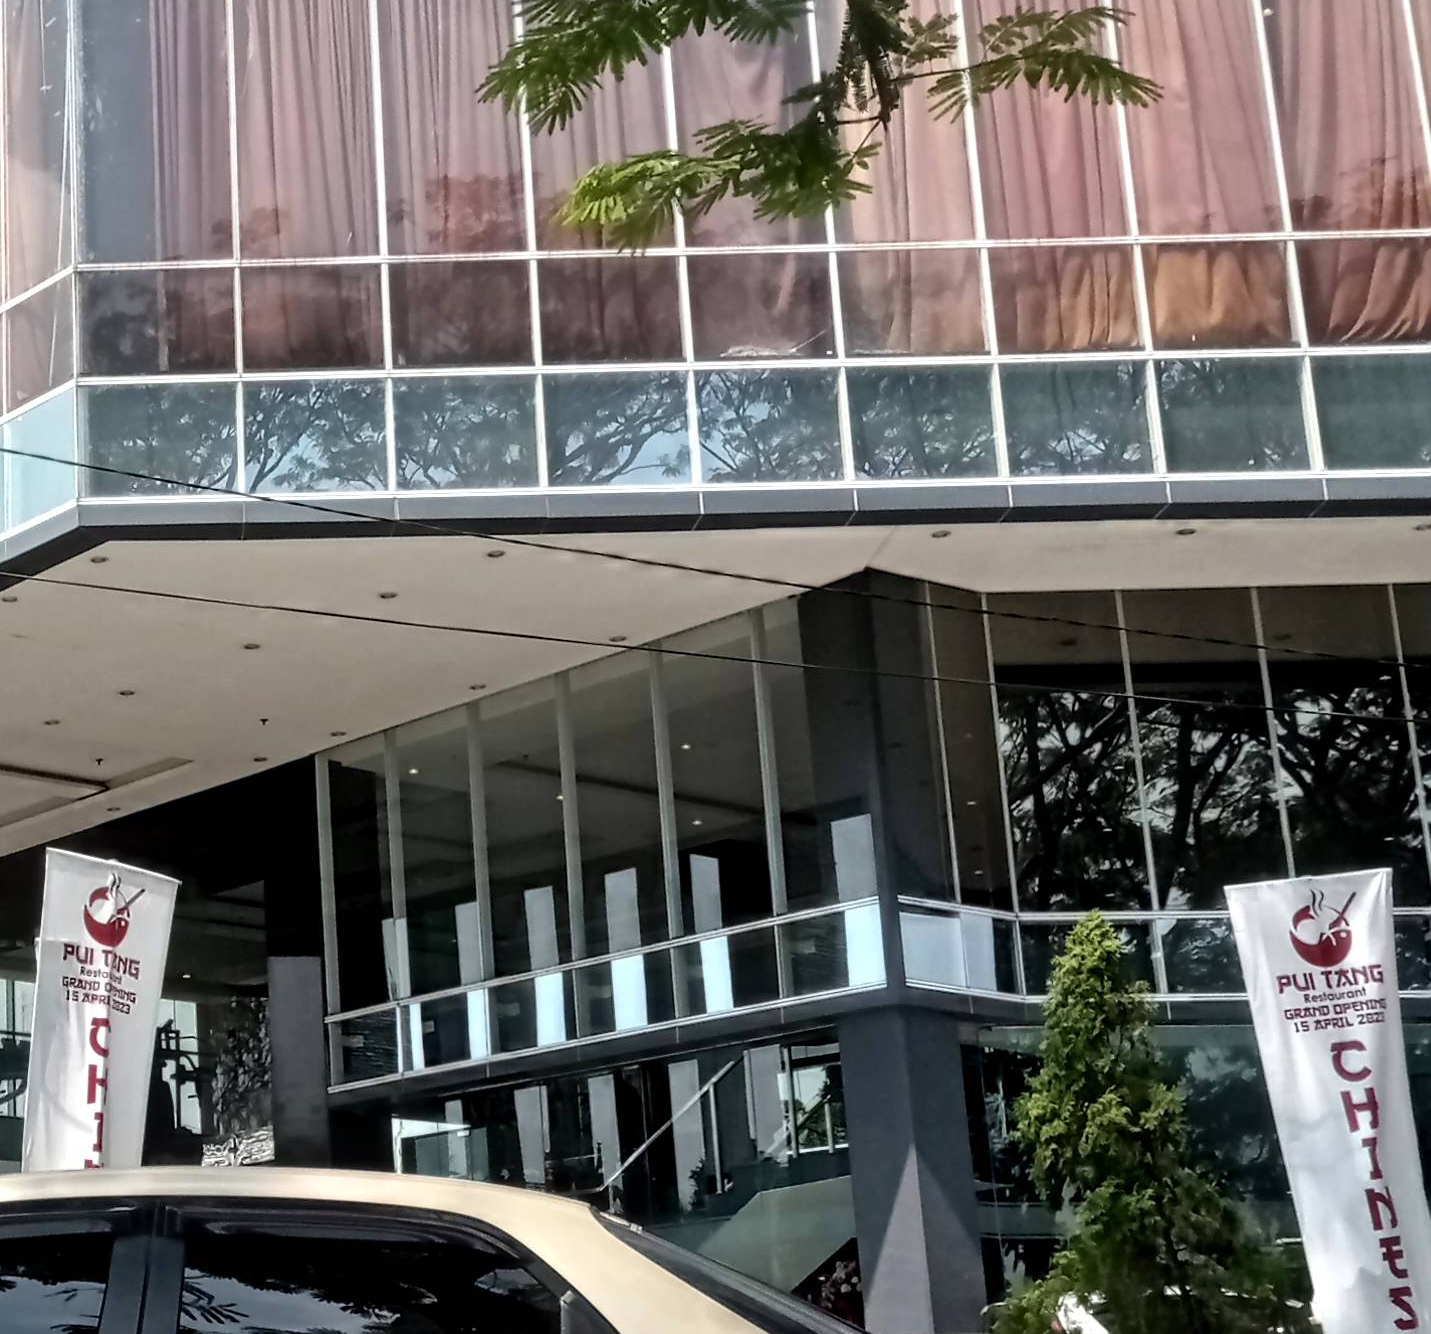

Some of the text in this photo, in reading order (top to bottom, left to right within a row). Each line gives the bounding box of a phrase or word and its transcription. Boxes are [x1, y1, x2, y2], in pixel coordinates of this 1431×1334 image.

[63, 943, 94, 966] PUI
[62, 976, 100, 991] GRAND
[1276, 964, 1384, 995] PUI TANG
[66, 990, 79, 1001] 15
[1304, 987, 1367, 1004] Restaurant
[1284, 998, 1387, 1020] GRAND OPENING
[1294, 1021, 1310, 1033] 15
[1314, 1017, 1354, 1031] APRIL
